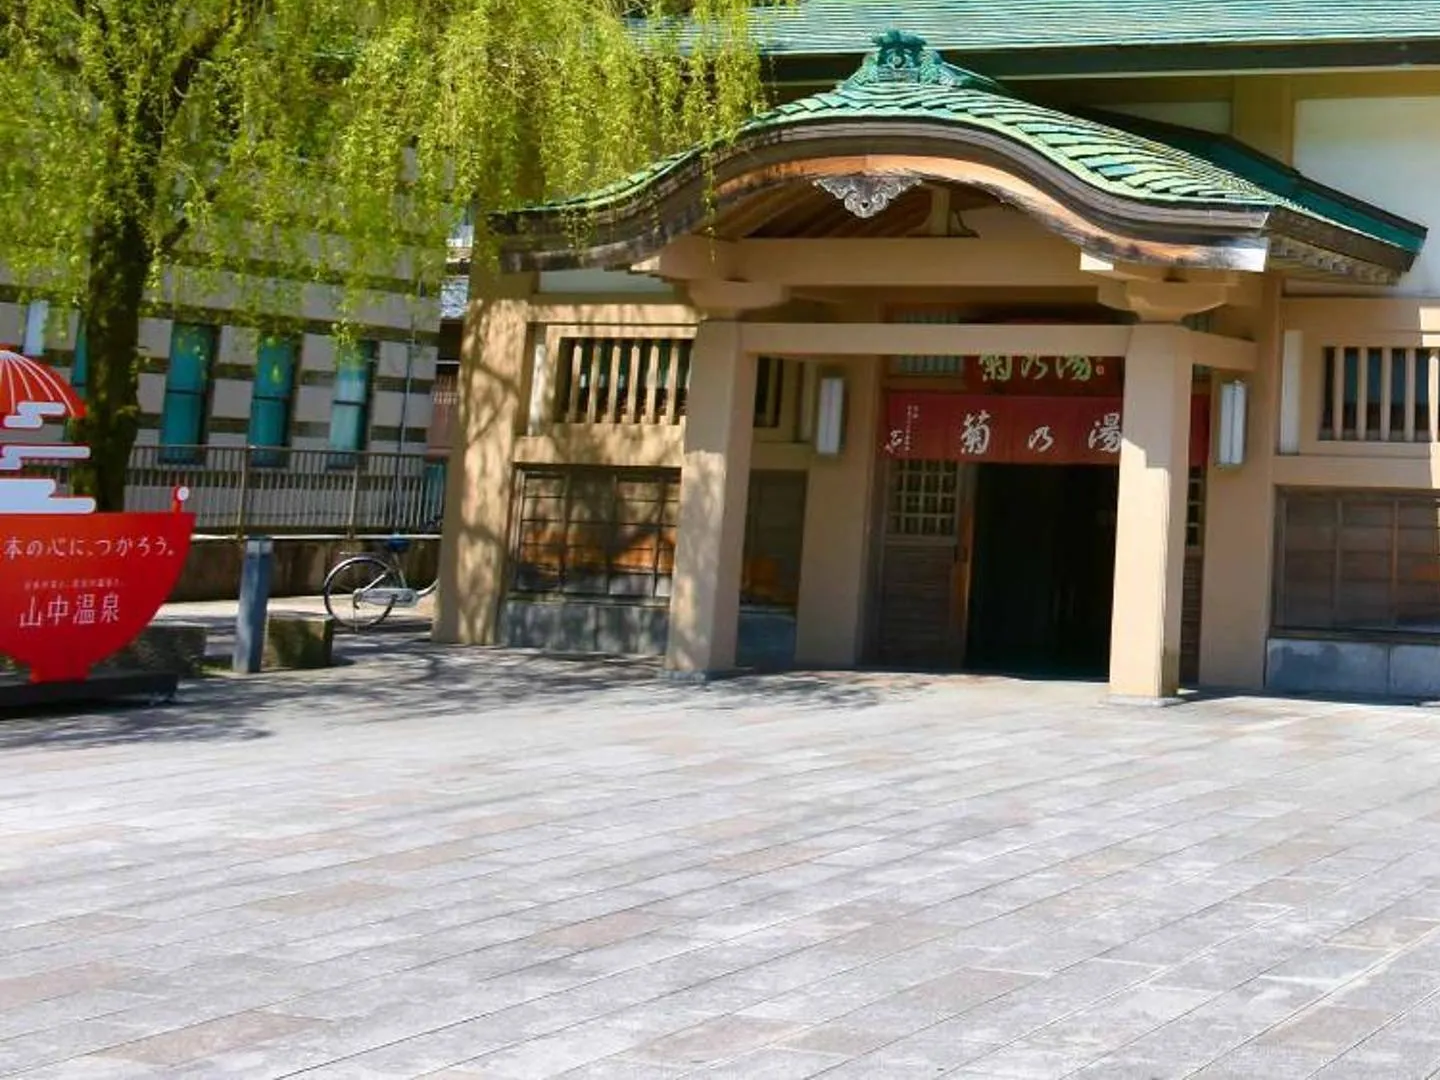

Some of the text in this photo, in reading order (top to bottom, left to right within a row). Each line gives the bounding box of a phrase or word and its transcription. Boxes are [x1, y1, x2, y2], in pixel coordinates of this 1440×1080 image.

[0, 536, 175, 560] 本の心に、つかろう。
[19, 592, 120, 627] 山中温泉
